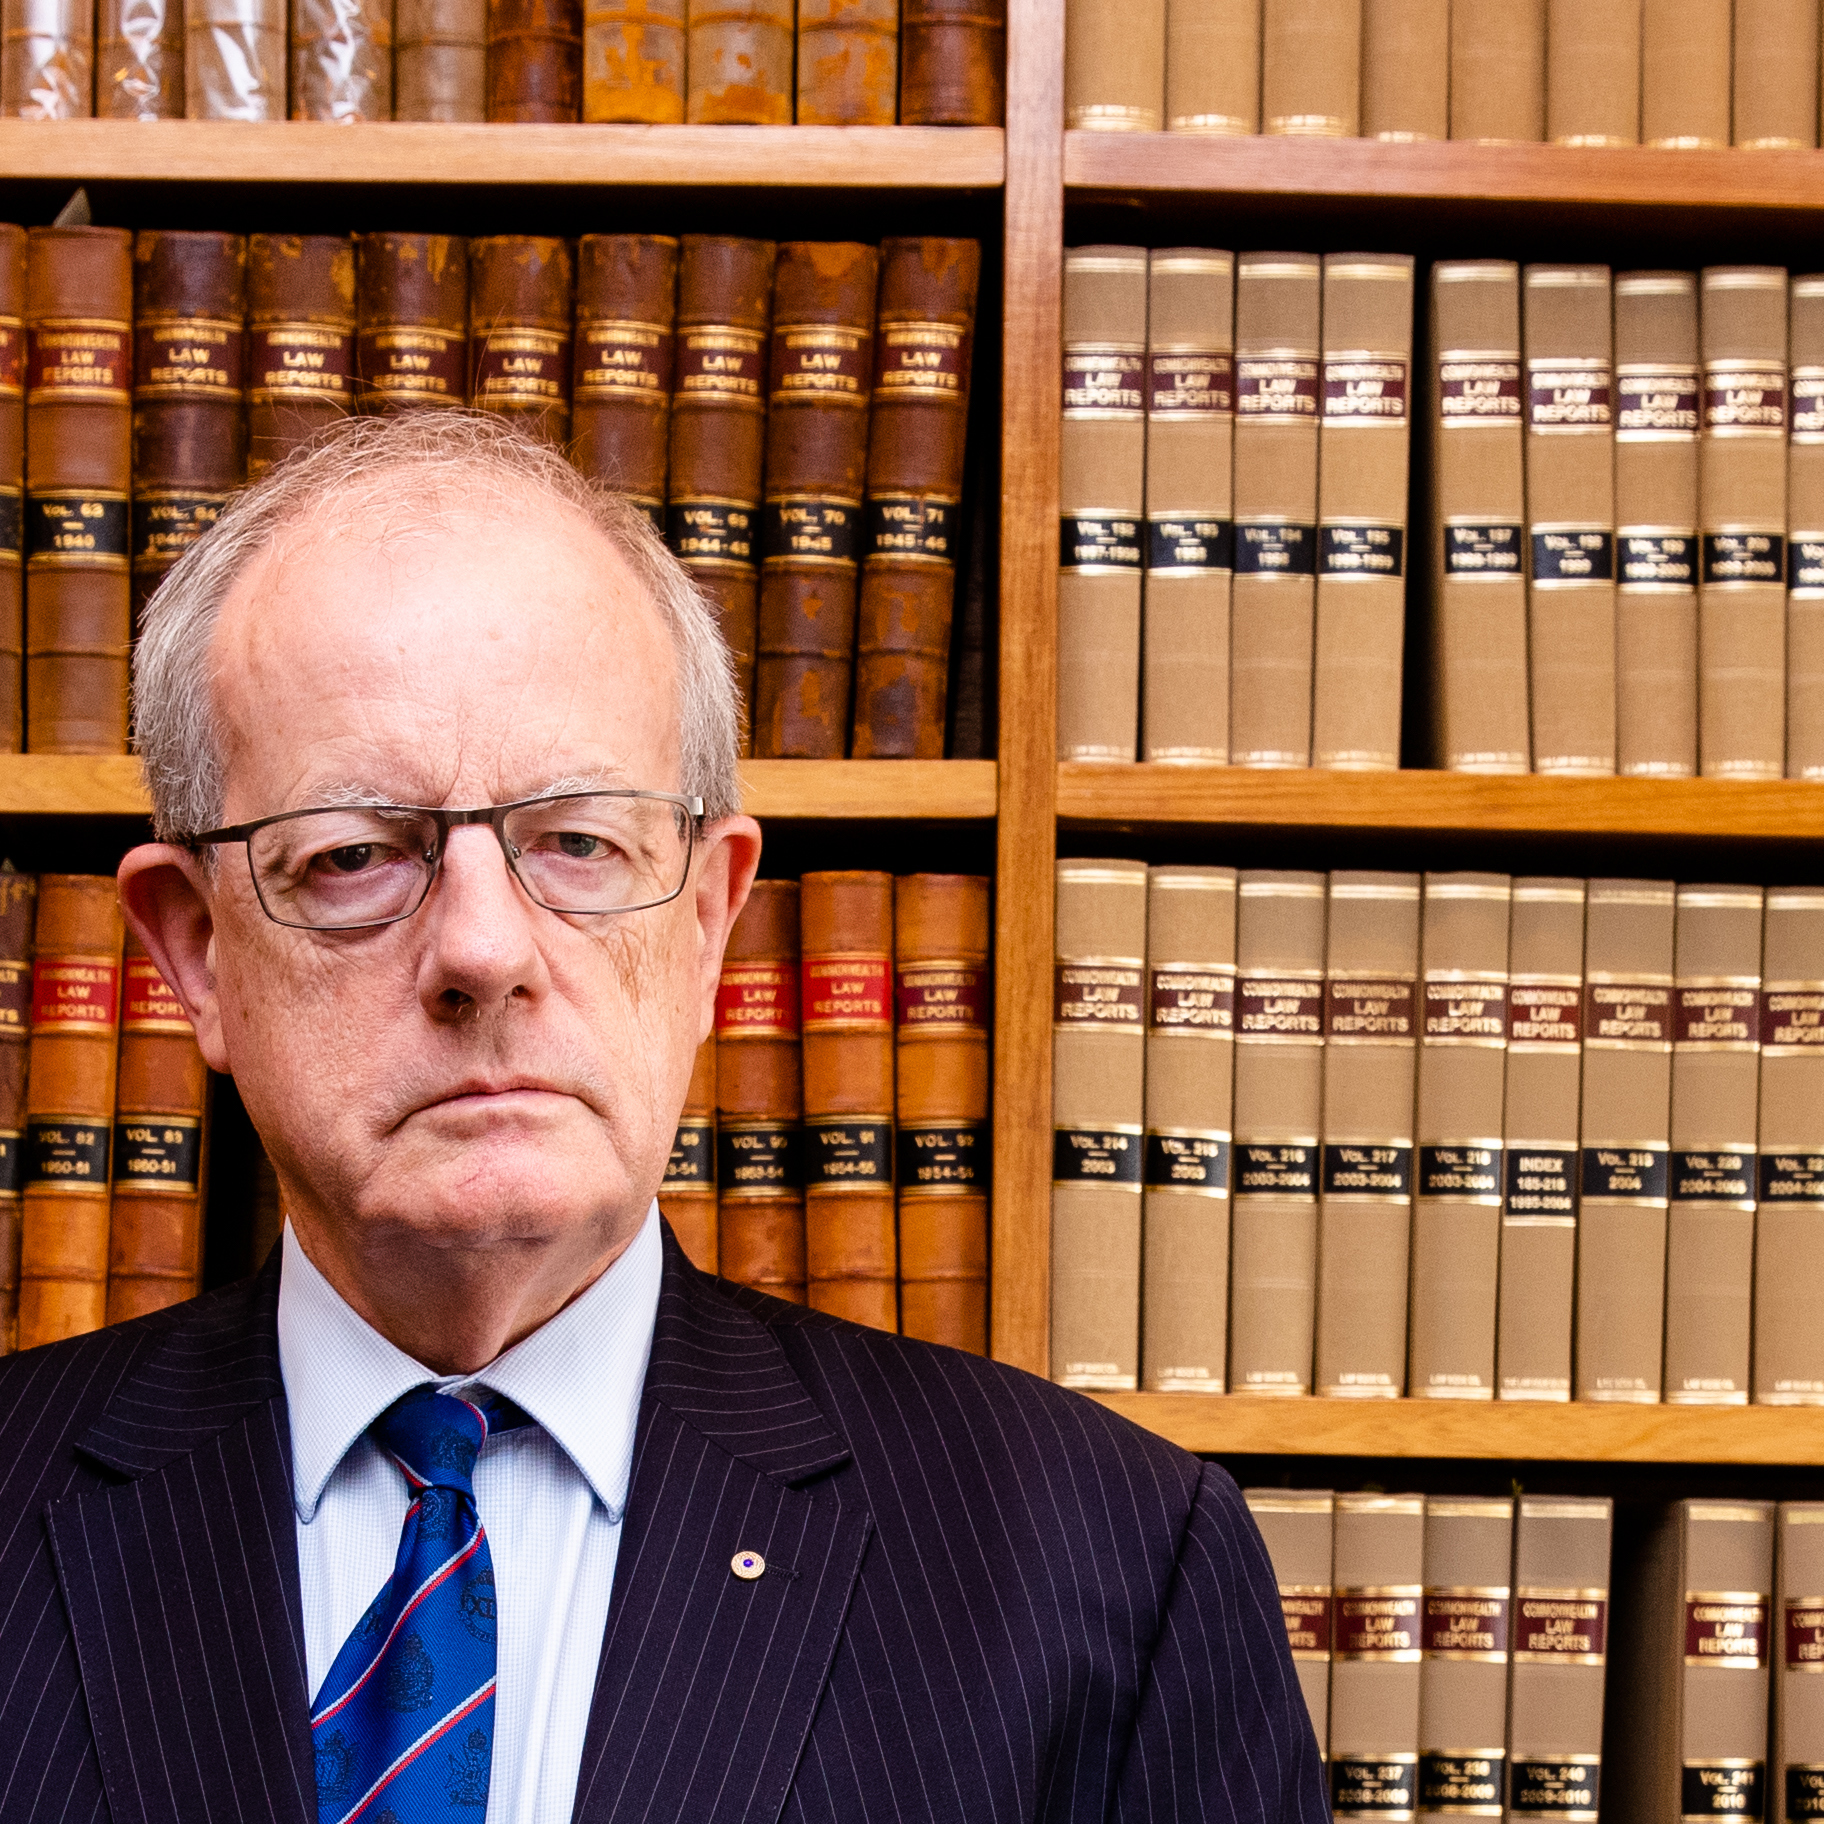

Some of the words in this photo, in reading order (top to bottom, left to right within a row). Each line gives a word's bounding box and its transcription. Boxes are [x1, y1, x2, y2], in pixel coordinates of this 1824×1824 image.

[62, 351, 95, 365] LAW
[703, 355, 743, 371] LAW
[801, 354, 841, 369] LAW
[901, 352, 942, 367] LAW
[43, 367, 113, 383] REPORTS
[882, 371, 958, 387] REPORTS
[1085, 372, 1122, 387] LAW
[684, 375, 758, 392] REPORTS
[1346, 382, 1384, 396] LAW
[1065, 389, 1142, 406] REPORTS
[1326, 398, 1403, 414] REPORTS
[927, 509, 944, 522] 71
[58, 985, 90, 998] LAW
[831, 982, 865, 994] LAW
[1083, 986, 1120, 1001] LAW
[814, 1001, 881, 1013] REPORTS
[1178, 992, 1214, 1008] LAW
[1264, 999, 1300, 1014] LAW
[1448, 1000, 1484, 1016] LAW
[41, 1002, 106, 1019] REPORTS
[1062, 1002, 1139, 1020] REPORTS
[1156, 1008, 1231, 1026] REPORTS
[1530, 1007, 1562, 1021] LAW
[1242, 1014, 1319, 1031] REPORTS
[1427, 1017, 1502, 1033] REPORTS
[1513, 1022, 1576, 1039] REPORTS
[1519, 1157, 1564, 1172] INDEX
[1366, 1617, 1395, 1632] LAW
[1545, 1620, 1574, 1635] LAW
[1349, 1631, 1411, 1648] REPORTS
[1529, 1634, 1590, 1650] REPORTS
